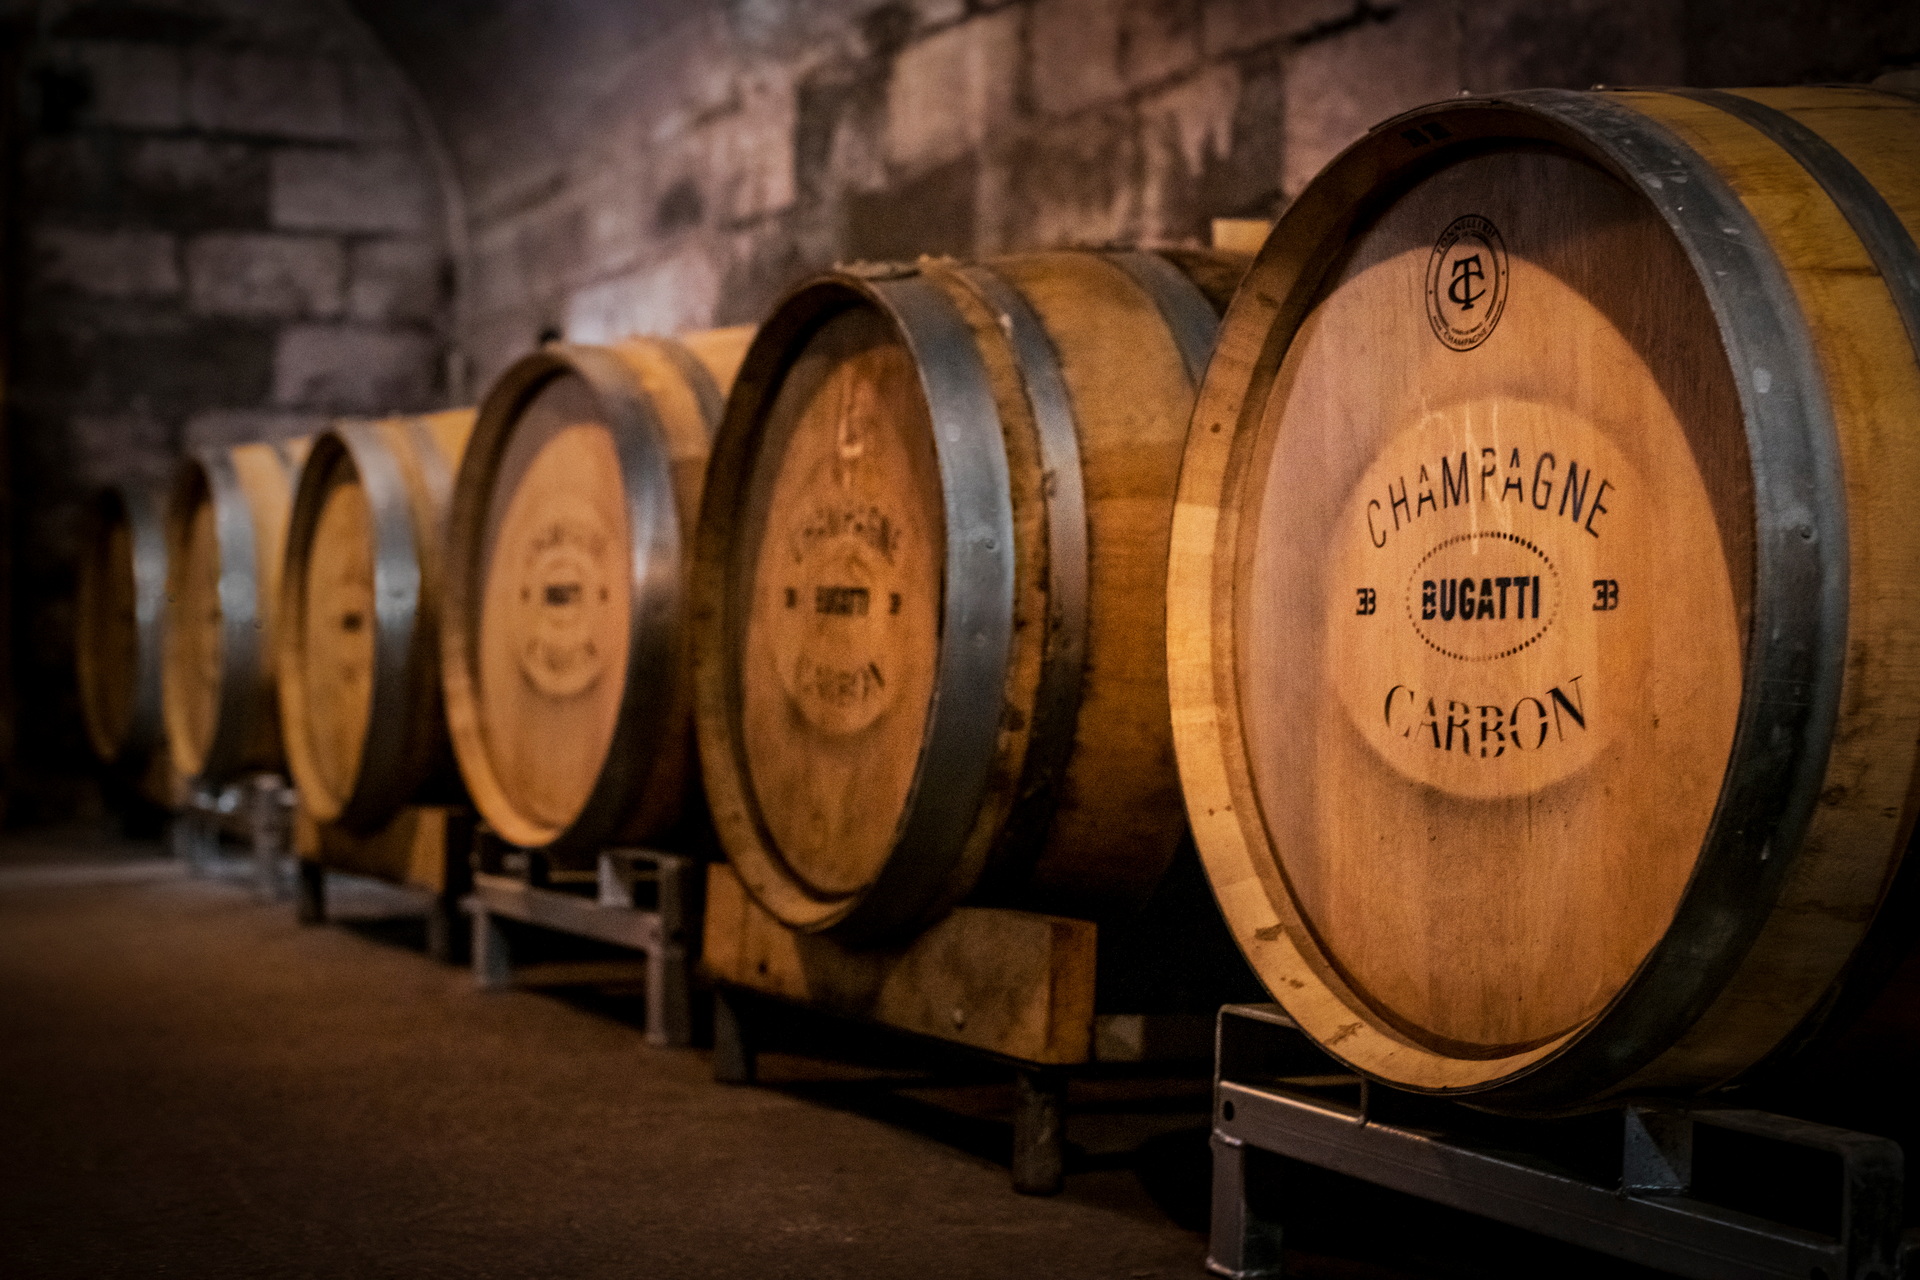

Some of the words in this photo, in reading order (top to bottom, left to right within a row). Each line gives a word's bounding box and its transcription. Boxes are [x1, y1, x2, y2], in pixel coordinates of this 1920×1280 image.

[1366, 447, 1616, 549] CHAMPAGNE
[1421, 575, 1540, 621] BUGATTI
[1383, 674, 1586, 758] CARBON
